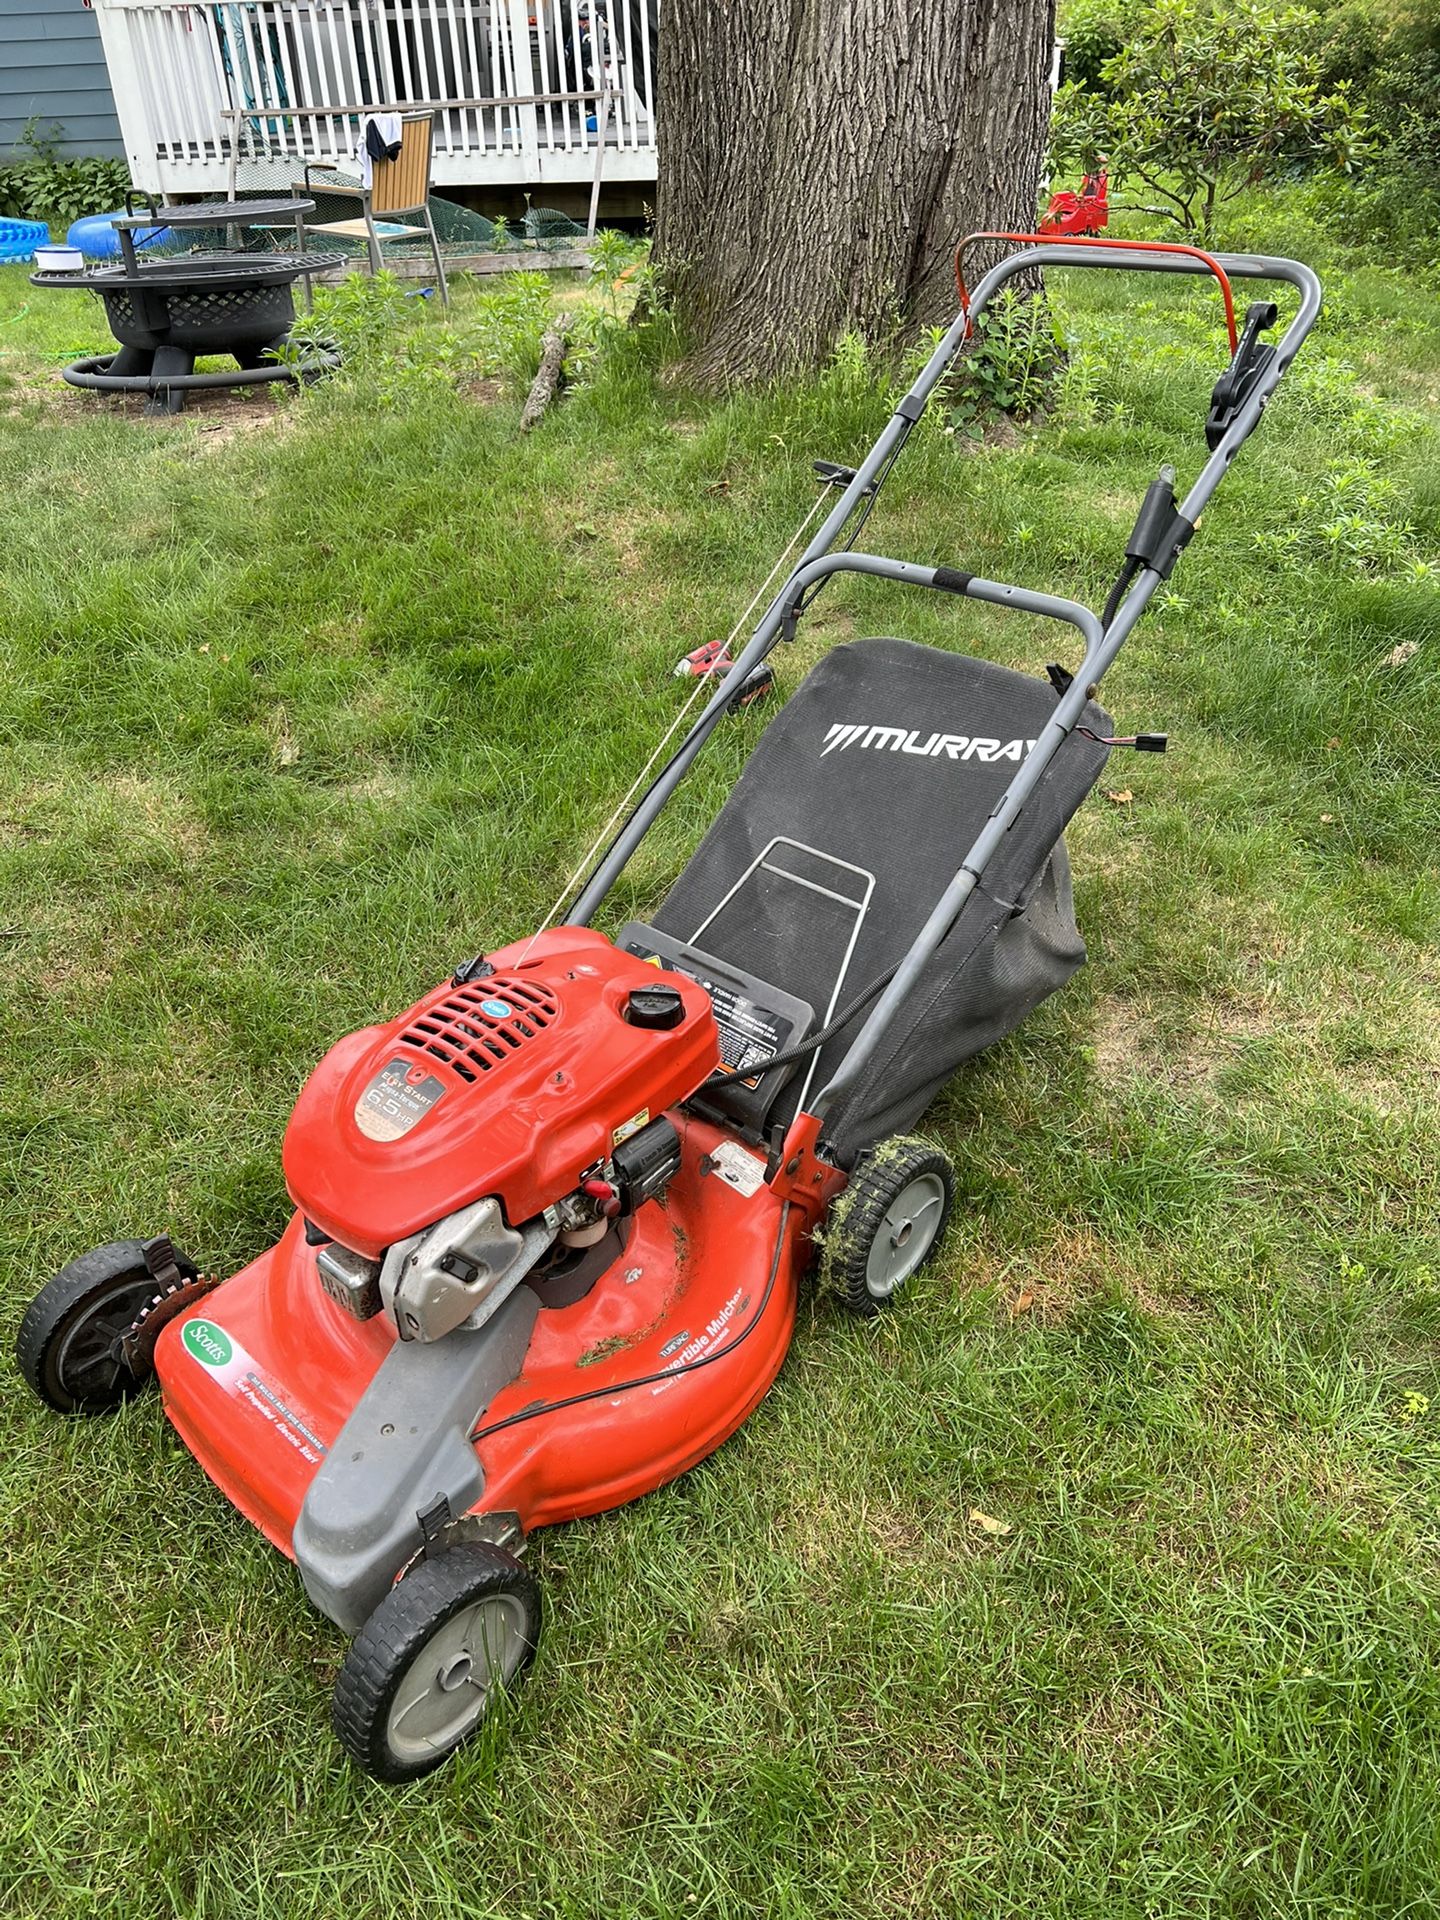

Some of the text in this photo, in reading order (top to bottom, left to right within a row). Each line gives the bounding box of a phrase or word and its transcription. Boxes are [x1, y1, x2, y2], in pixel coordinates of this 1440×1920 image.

[403, 1085, 432, 1105] START
[705, 1287, 742, 1337] Mulcher
[189, 1325, 226, 1361] Scotts
[275, 1423, 302, 1448] Electric
[299, 1446, 320, 1464] Start
